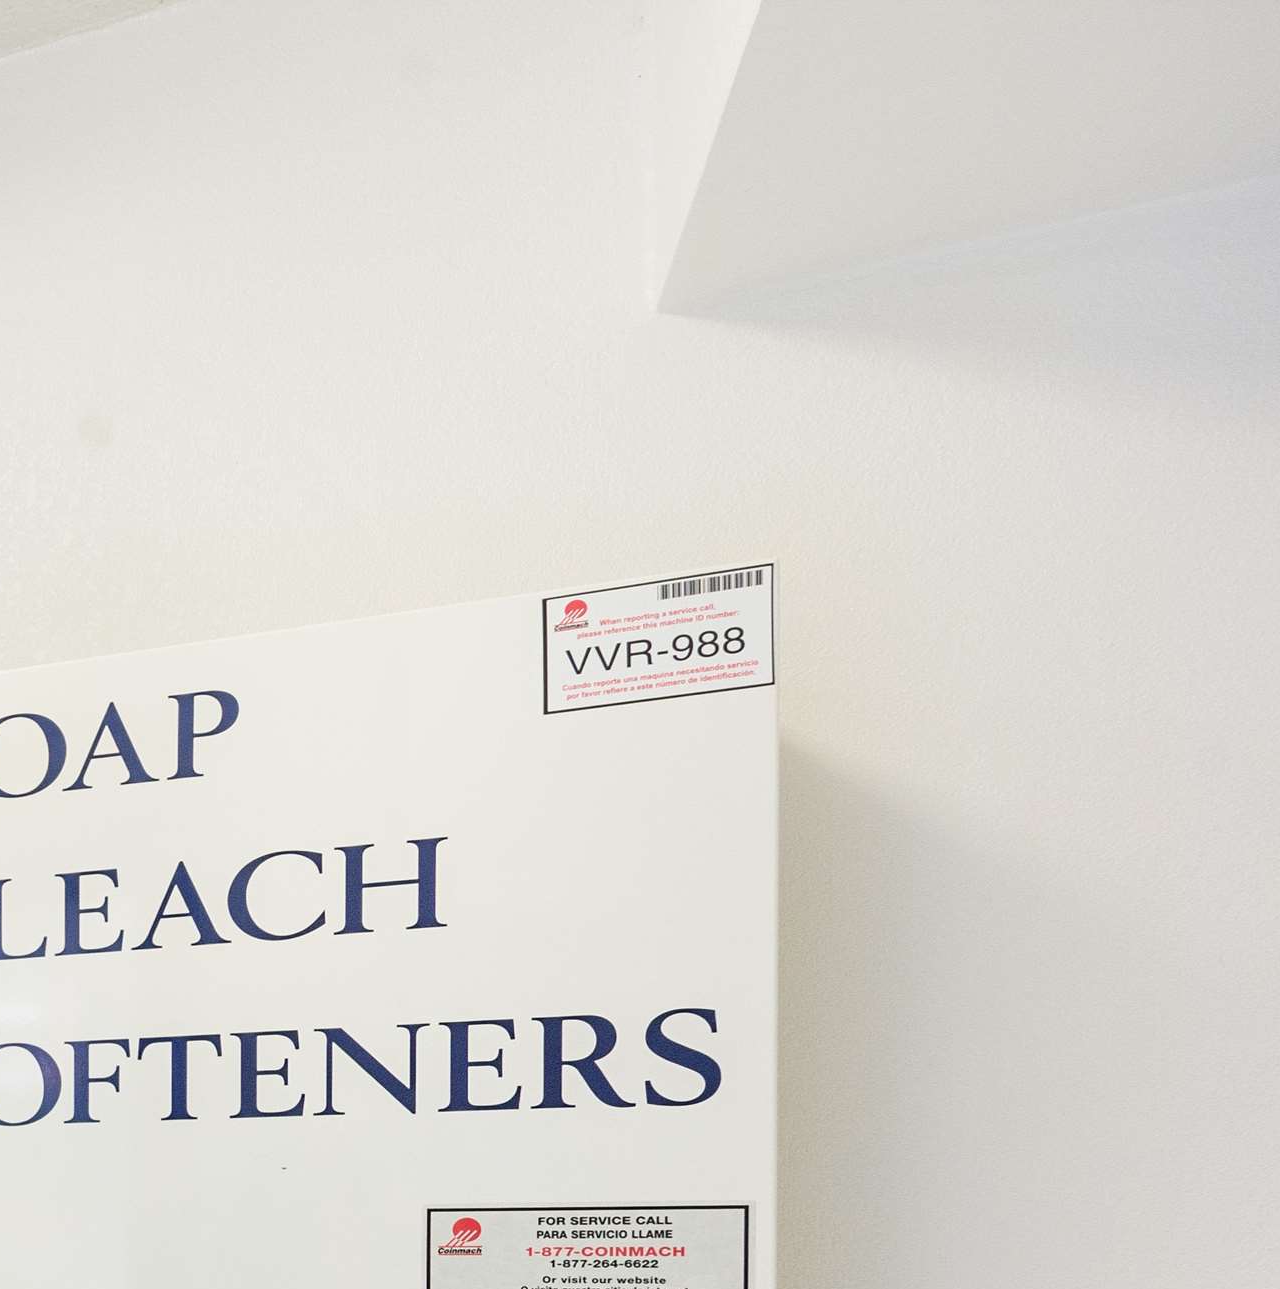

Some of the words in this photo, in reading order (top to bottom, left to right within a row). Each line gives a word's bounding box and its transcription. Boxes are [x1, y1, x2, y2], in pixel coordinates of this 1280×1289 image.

[624, 612, 659, 623] reporting
[669, 607, 697, 615] service
[577, 631, 602, 639] please
[604, 626, 641, 635] reference
[659, 617, 693, 627] machine
[565, 626, 745, 675] VVR-988
[562, 682, 592, 691] Cuando
[593, 679, 622, 689] reporte
[676, 664, 724, 676] necesitando
[727, 660, 759, 669] servicio
[603, 686, 628, 695] refiere
[537, 1217, 566, 1226] FOR
[570, 1216, 632, 1225] SERVICE
[636, 1216, 673, 1225] CALL
[536, 1230, 568, 1239] PARA
[571, 1230, 628, 1239] SERVICIO
[631, 1230, 673, 1239] LLAME
[437, 1247, 482, 1255] Coinmach
[526, 1246, 686, 1257] 1-877-COINMACH
[550, 1259, 659, 1268] 1-877-264-6622
[542, 1276, 557, 1284] Or
[561, 1276, 587, 1284] visit
[616, 1276, 667, 1285] website
